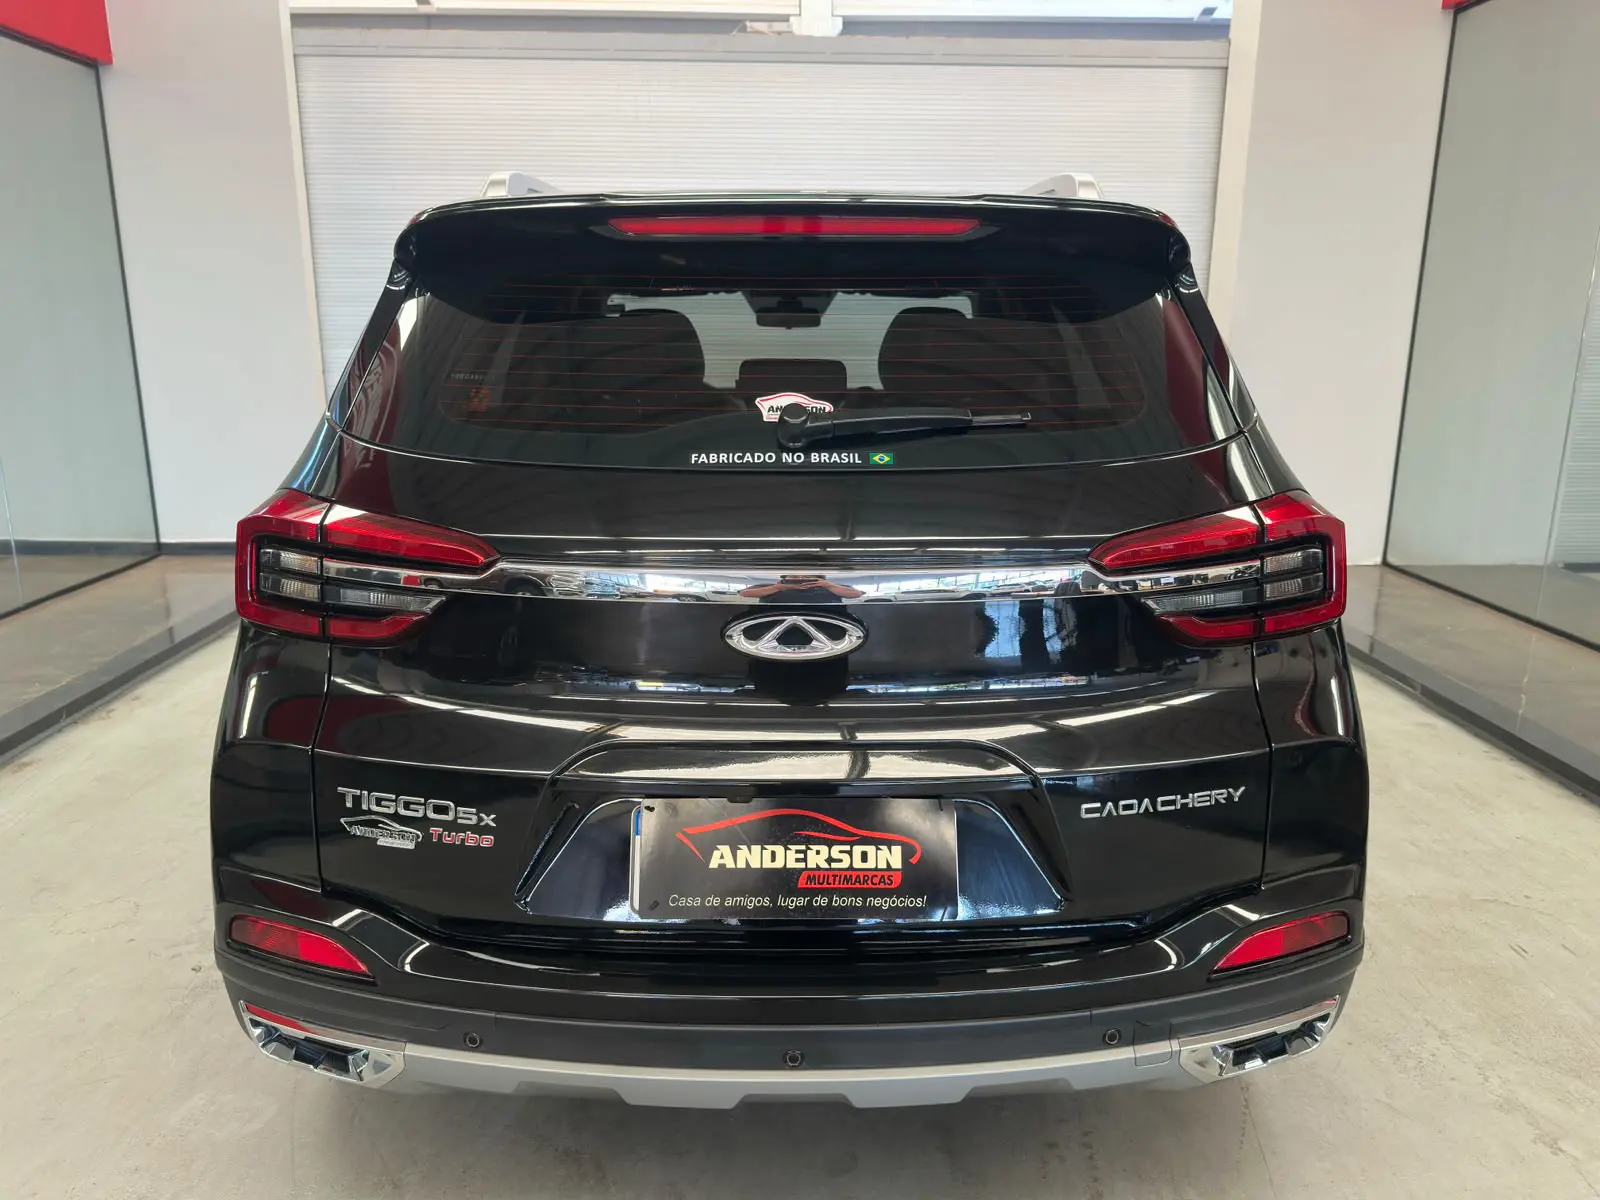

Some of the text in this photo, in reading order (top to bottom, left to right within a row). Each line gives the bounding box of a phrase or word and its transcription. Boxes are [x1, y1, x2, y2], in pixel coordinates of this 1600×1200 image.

[767, 405, 826, 414] ANSON
[691, 452, 862, 464] FABRICADO NO BRASIL
[429, 827, 495, 848] Turbo
[708, 844, 902, 869] ANDERSON
[804, 873, 894, 887] MULTIMARCAS
[668, 894, 927, 909] Casa de amigos, lugar de bons negócios!
